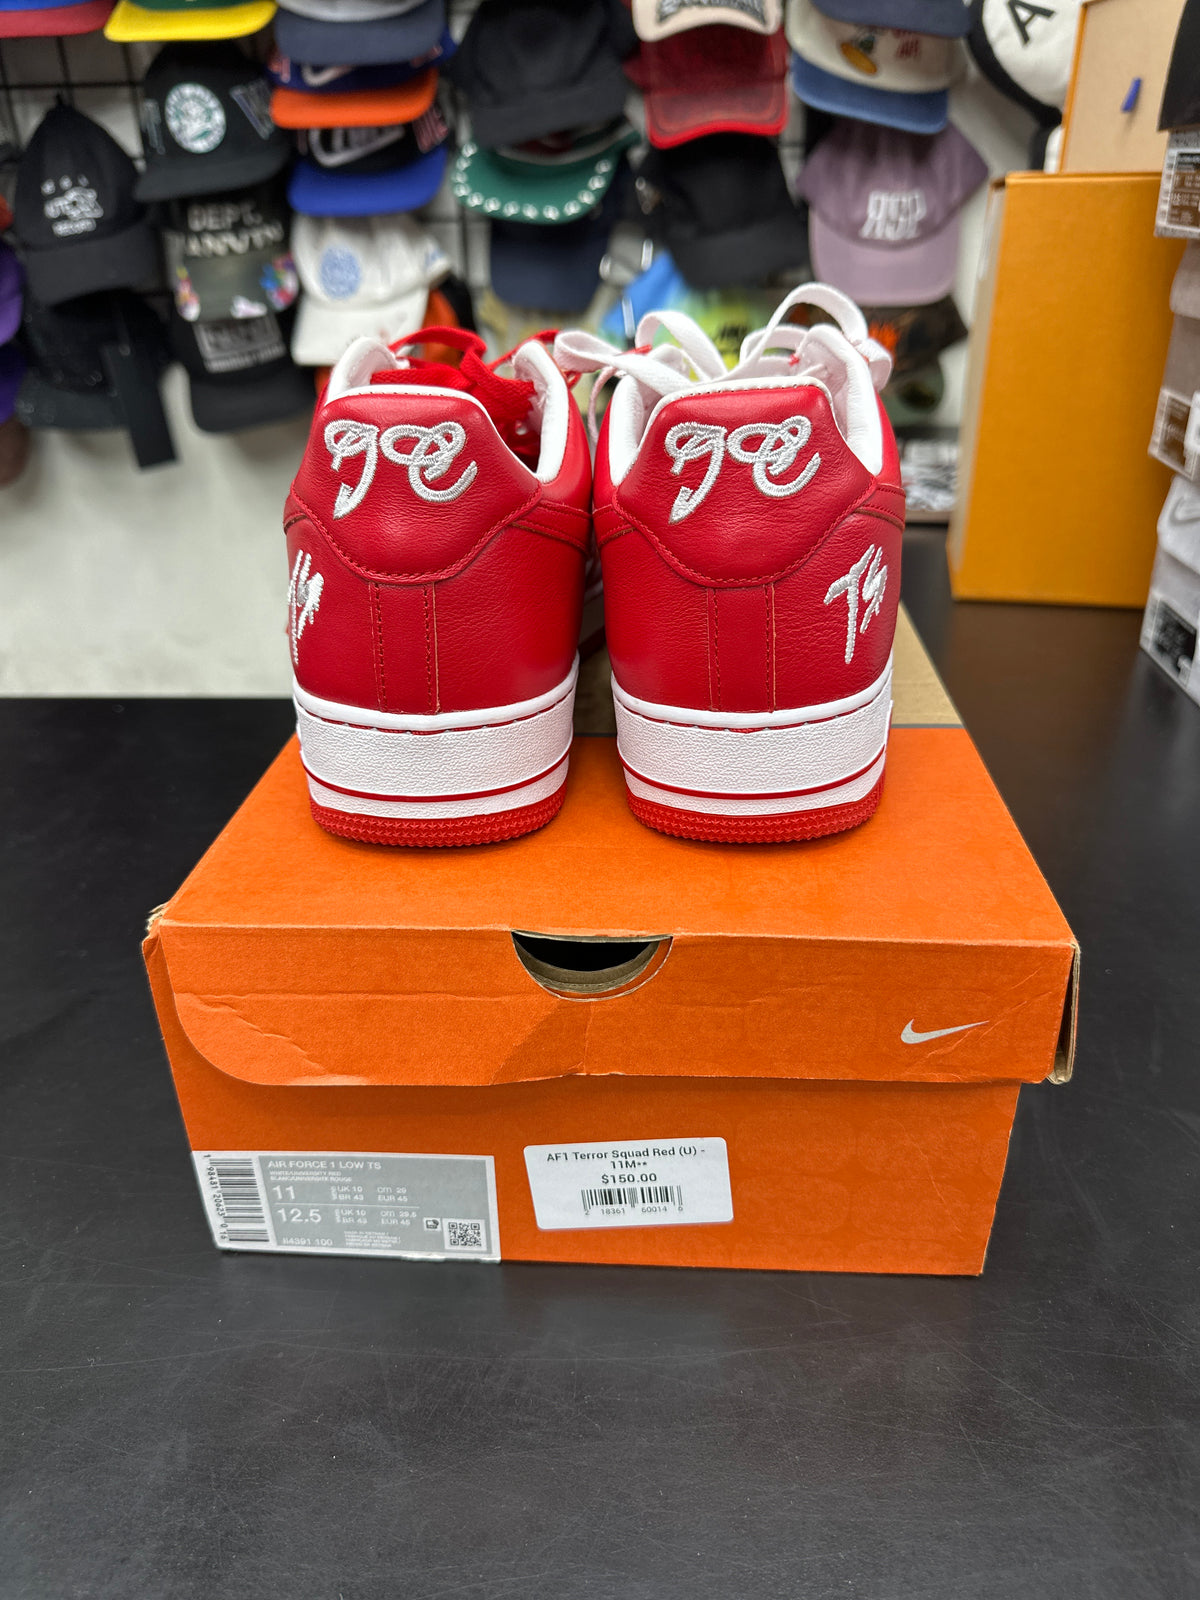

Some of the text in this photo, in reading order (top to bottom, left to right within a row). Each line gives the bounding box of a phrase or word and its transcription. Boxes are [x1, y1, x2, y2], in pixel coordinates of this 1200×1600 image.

[546, 1152, 569, 1162] AF1
[572, 1150, 609, 1160] Terror
[612, 1147, 650, 1160] Squad
[653, 1146, 676, 1157] Red
[679, 1145, 697, 1157] (U)
[268, 1160, 382, 1170] AIR FORCE 1 LOW TS
[601, 1173, 657, 1185] $150.00
[272, 1185, 296, 1201] 11
[277, 1207, 322, 1224] 12.5
[601, 1207, 626, 1215] 18361
[641, 1205, 668, 1213] 60014
[316, 1238, 333, 1247] 100
